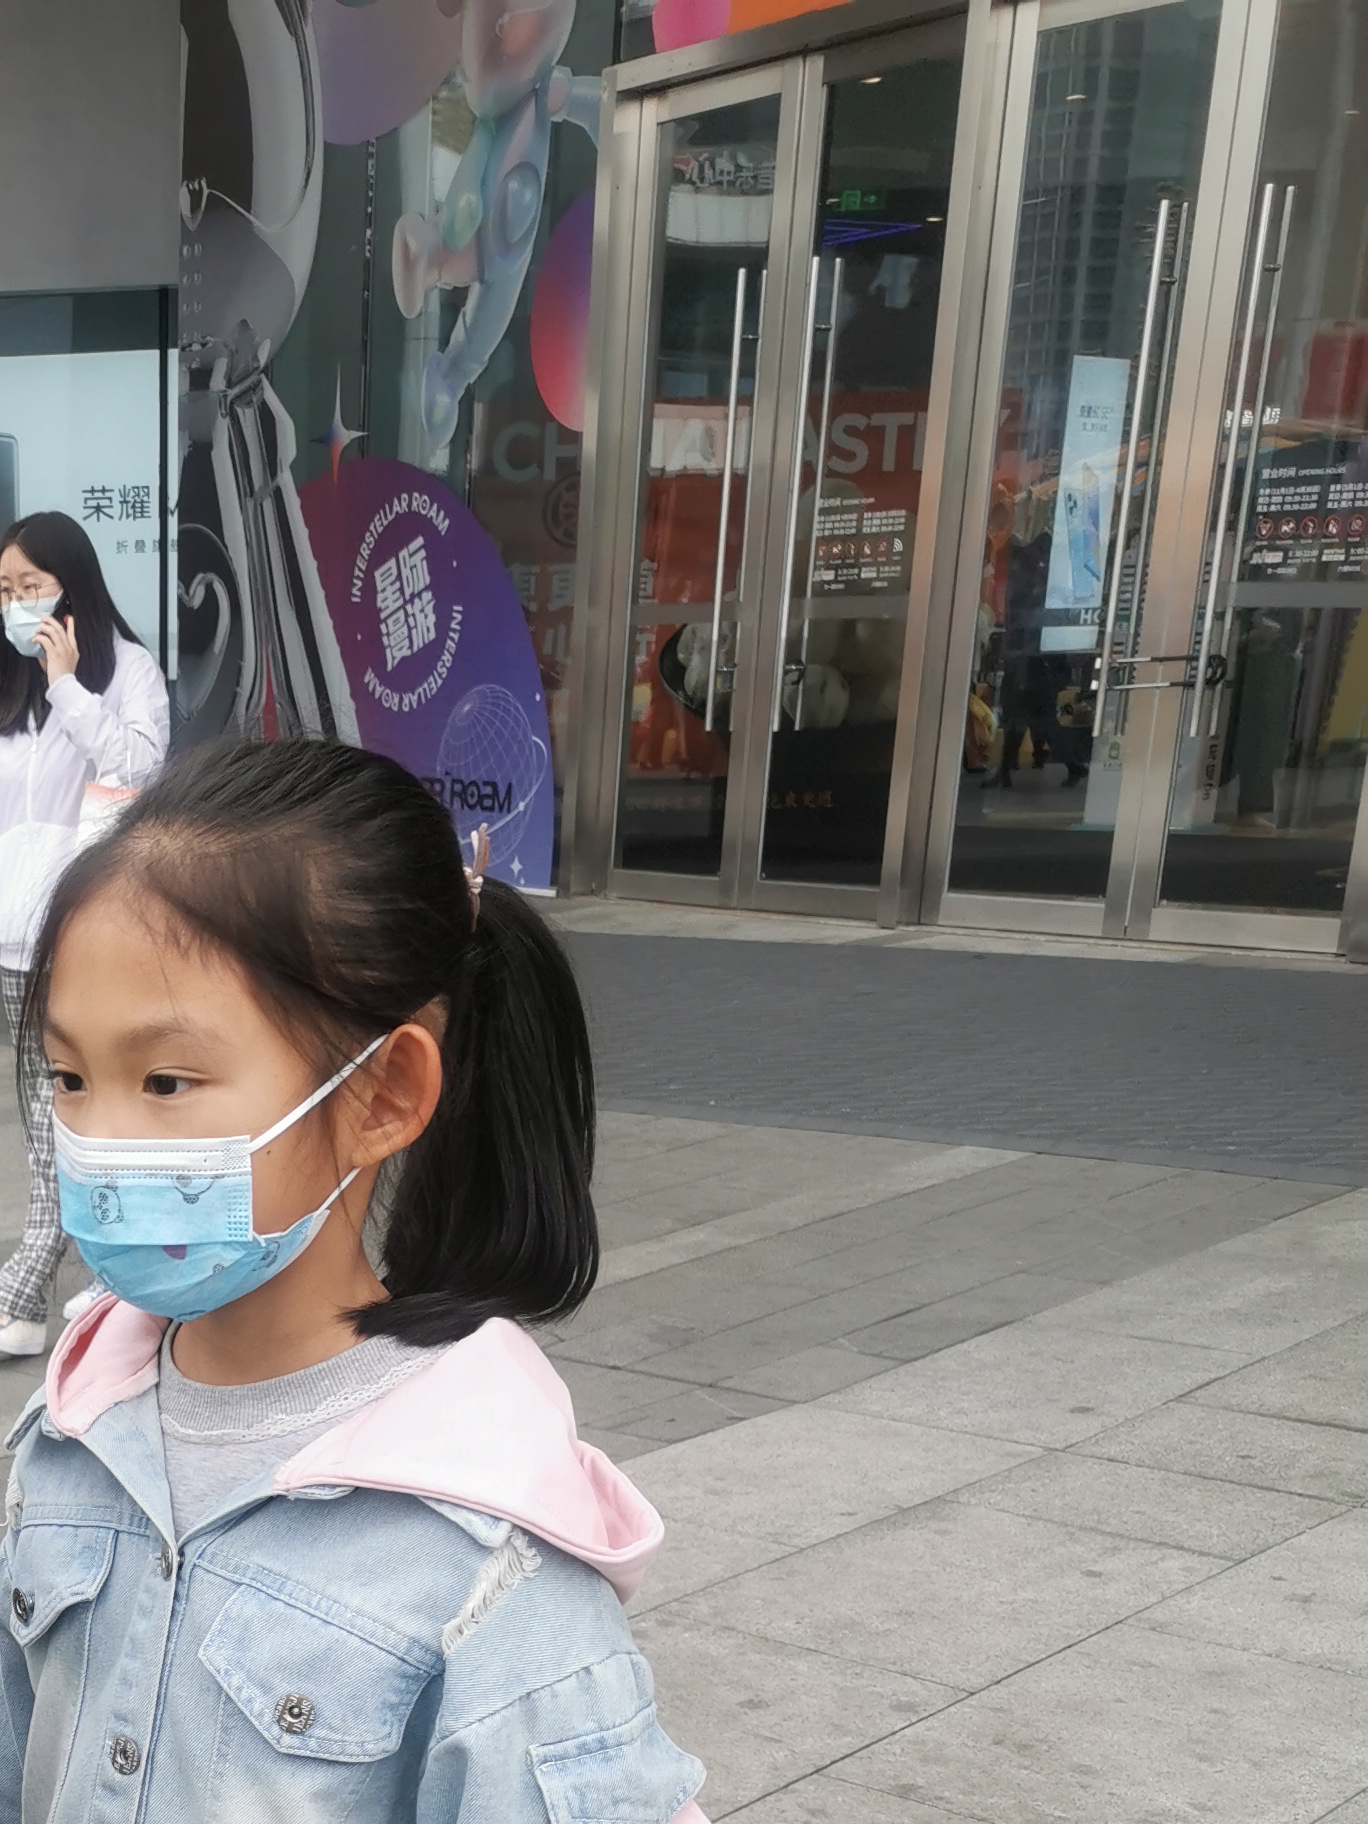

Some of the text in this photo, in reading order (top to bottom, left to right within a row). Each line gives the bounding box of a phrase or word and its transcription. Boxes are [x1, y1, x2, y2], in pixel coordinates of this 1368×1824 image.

[81, 484, 152, 522] 荣耀
[351, 492, 450, 603] INTERSTELLAR ROAM
[374, 534, 431, 620] 星际
[380, 590, 437, 672] 漫游
[401, 604, 463, 712] INTERSTELLAR
[363, 667, 400, 712] ROAM
